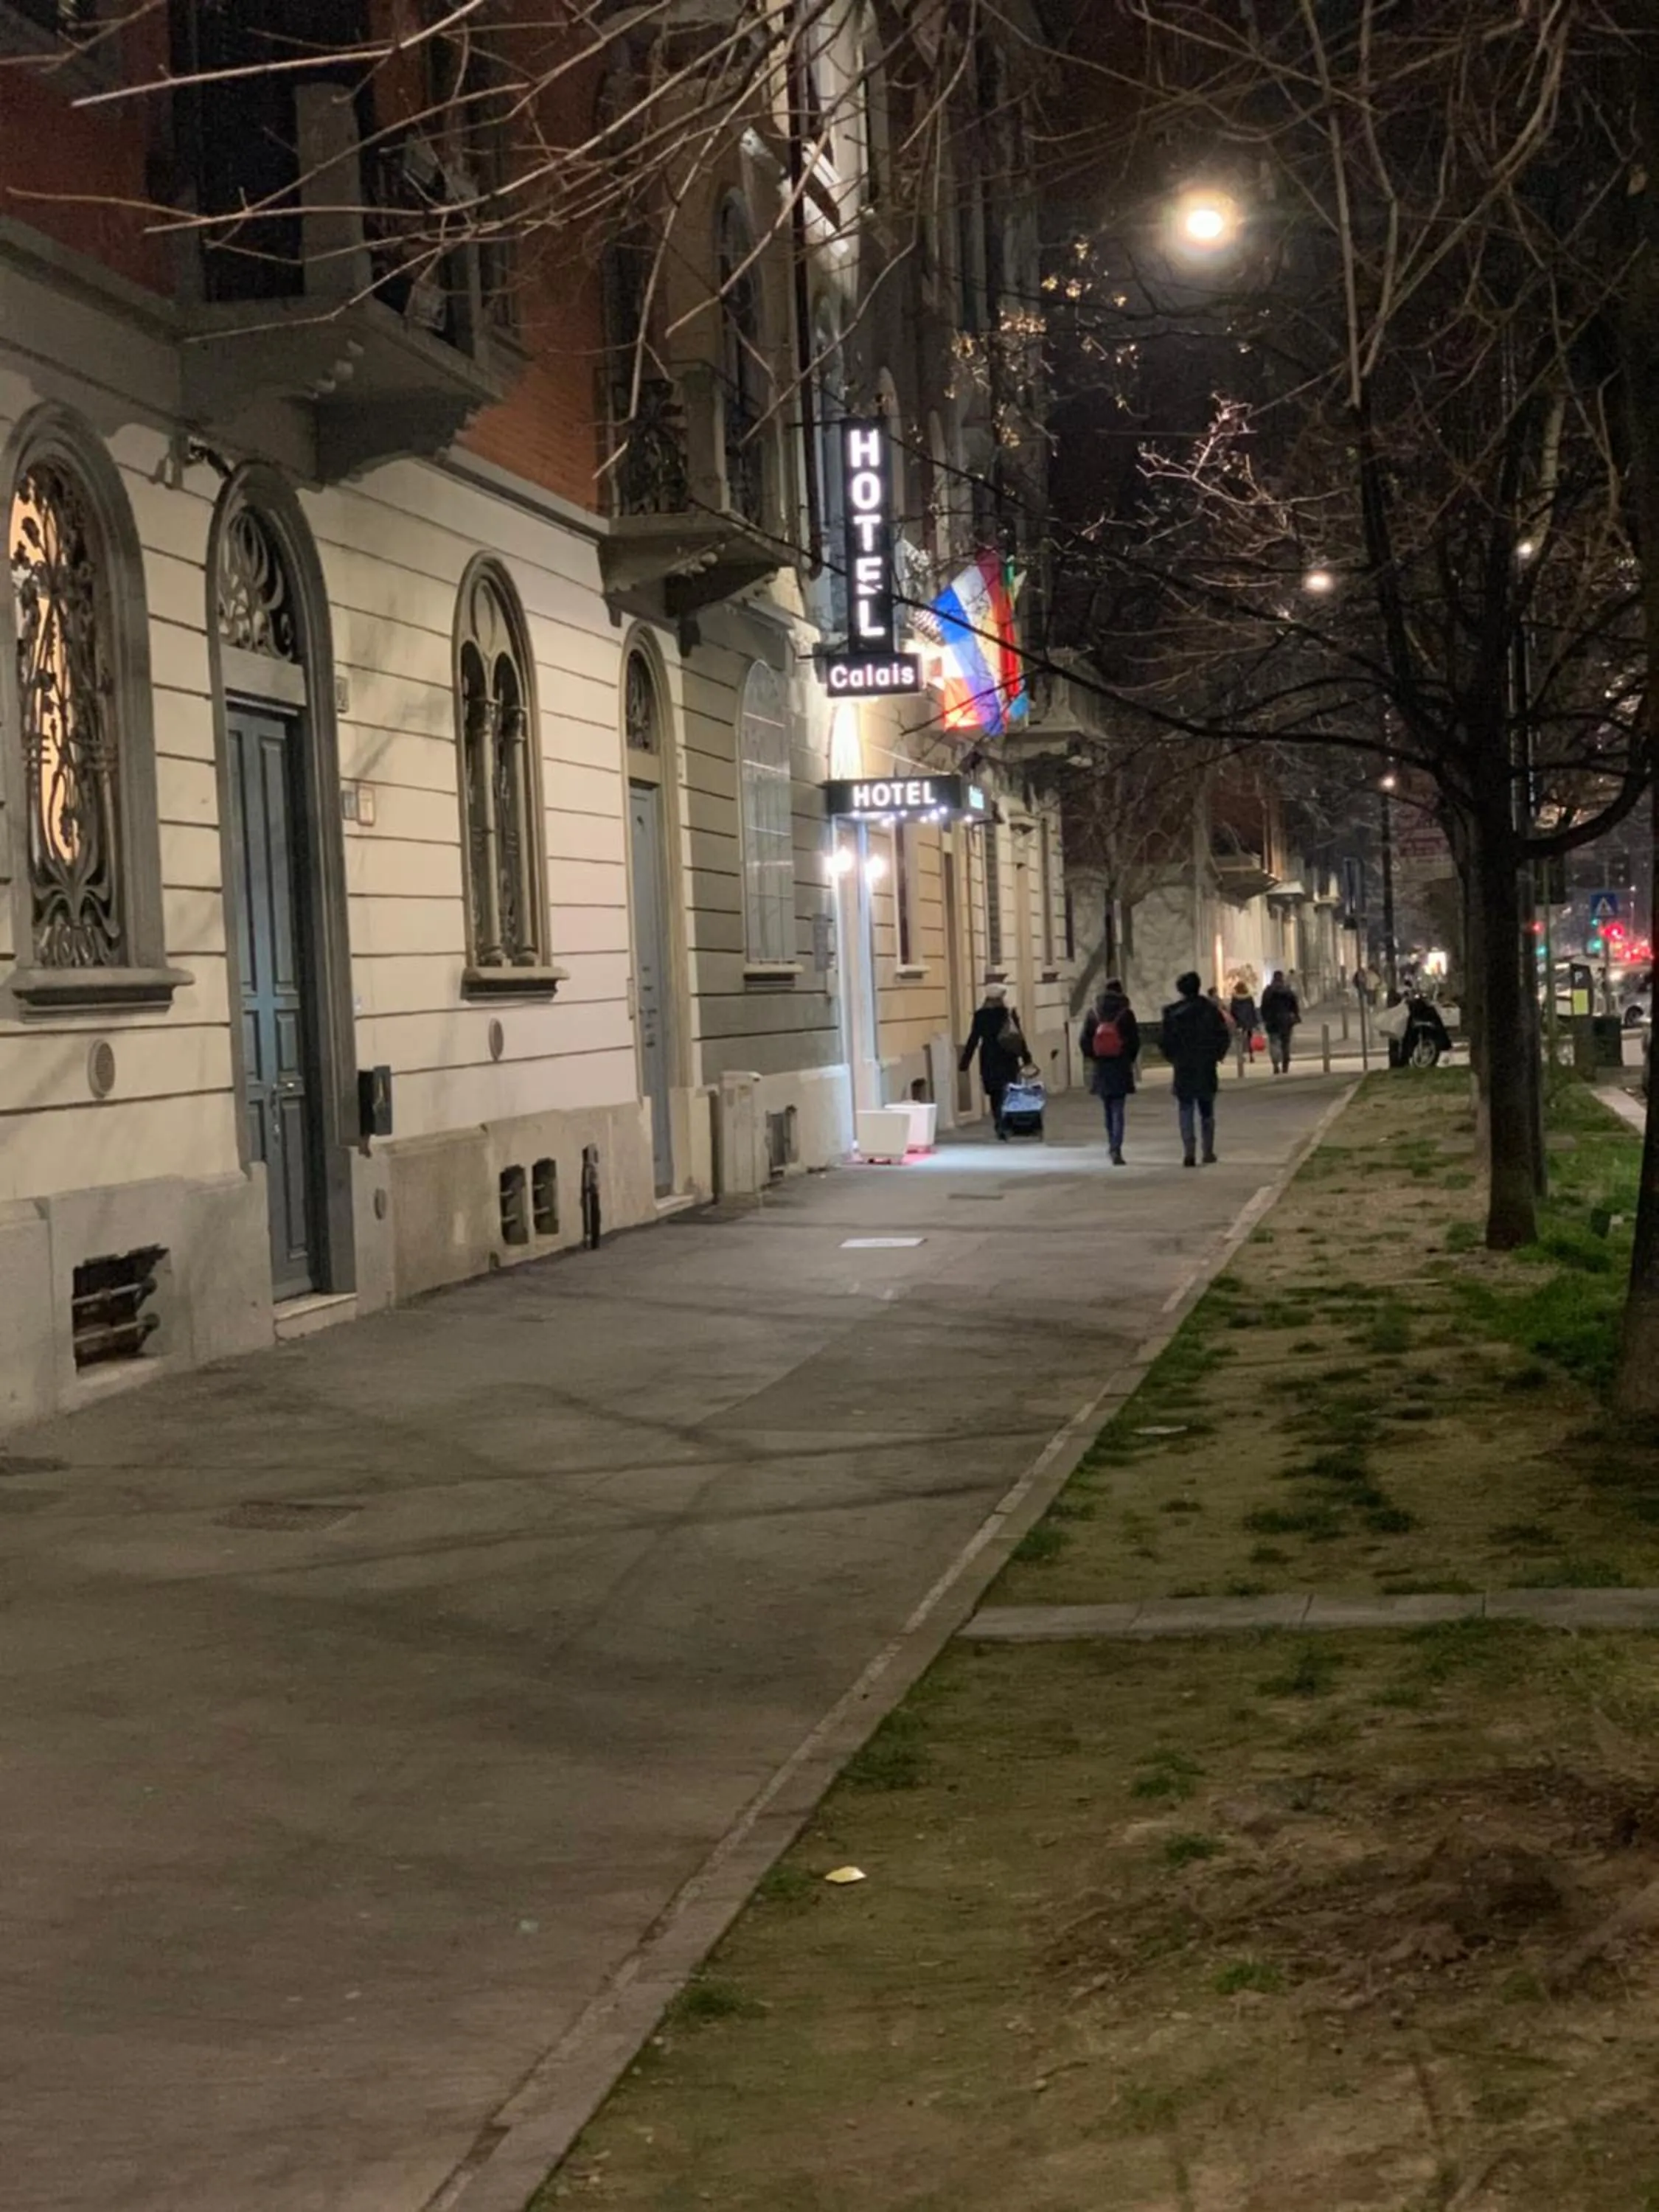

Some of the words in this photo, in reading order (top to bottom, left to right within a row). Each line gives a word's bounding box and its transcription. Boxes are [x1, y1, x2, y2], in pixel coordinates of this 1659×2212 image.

[849, 428, 885, 636] HOTEL
[830, 662, 914, 688] Calais
[852, 781, 937, 807] HOTEL
